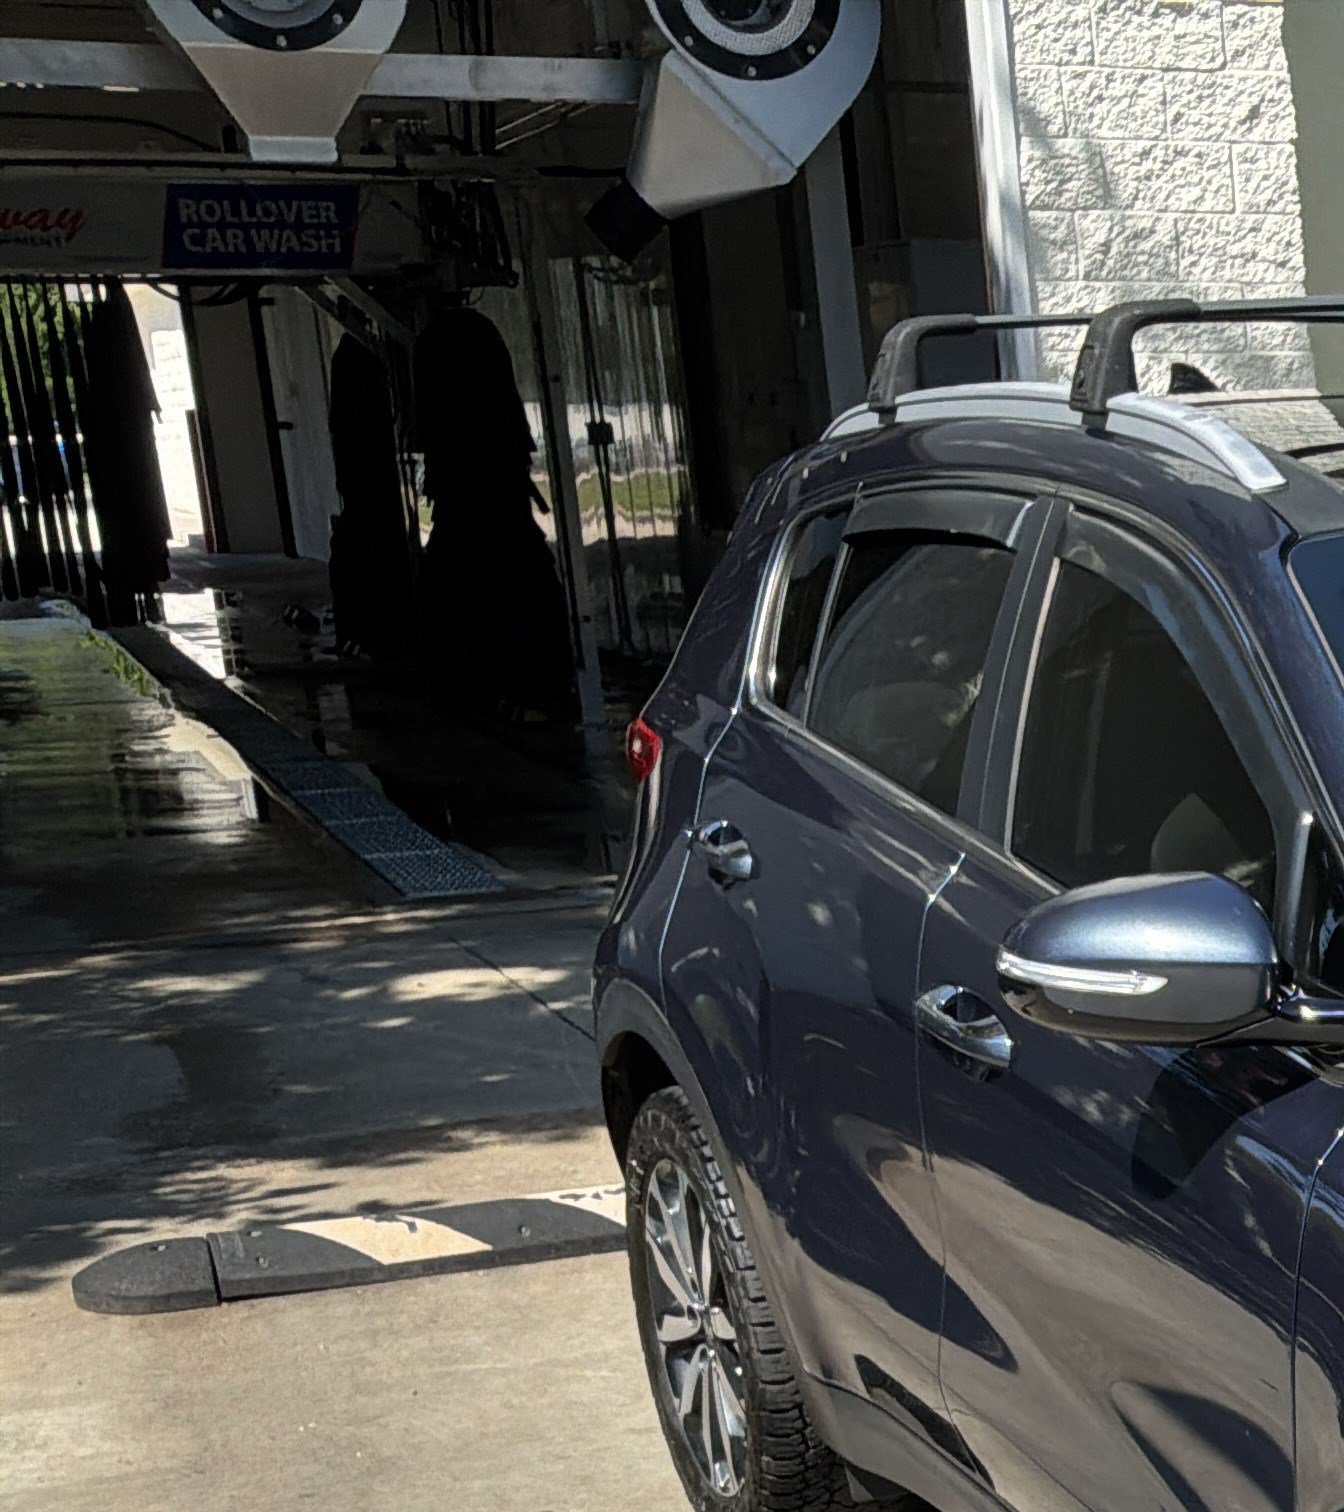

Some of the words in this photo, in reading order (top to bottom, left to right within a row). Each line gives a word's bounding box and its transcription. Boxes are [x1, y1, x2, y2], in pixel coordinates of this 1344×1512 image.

[178, 199, 340, 225] ROLLOVER
[182, 228, 247, 254] CAR
[250, 229, 342, 254] WASH
